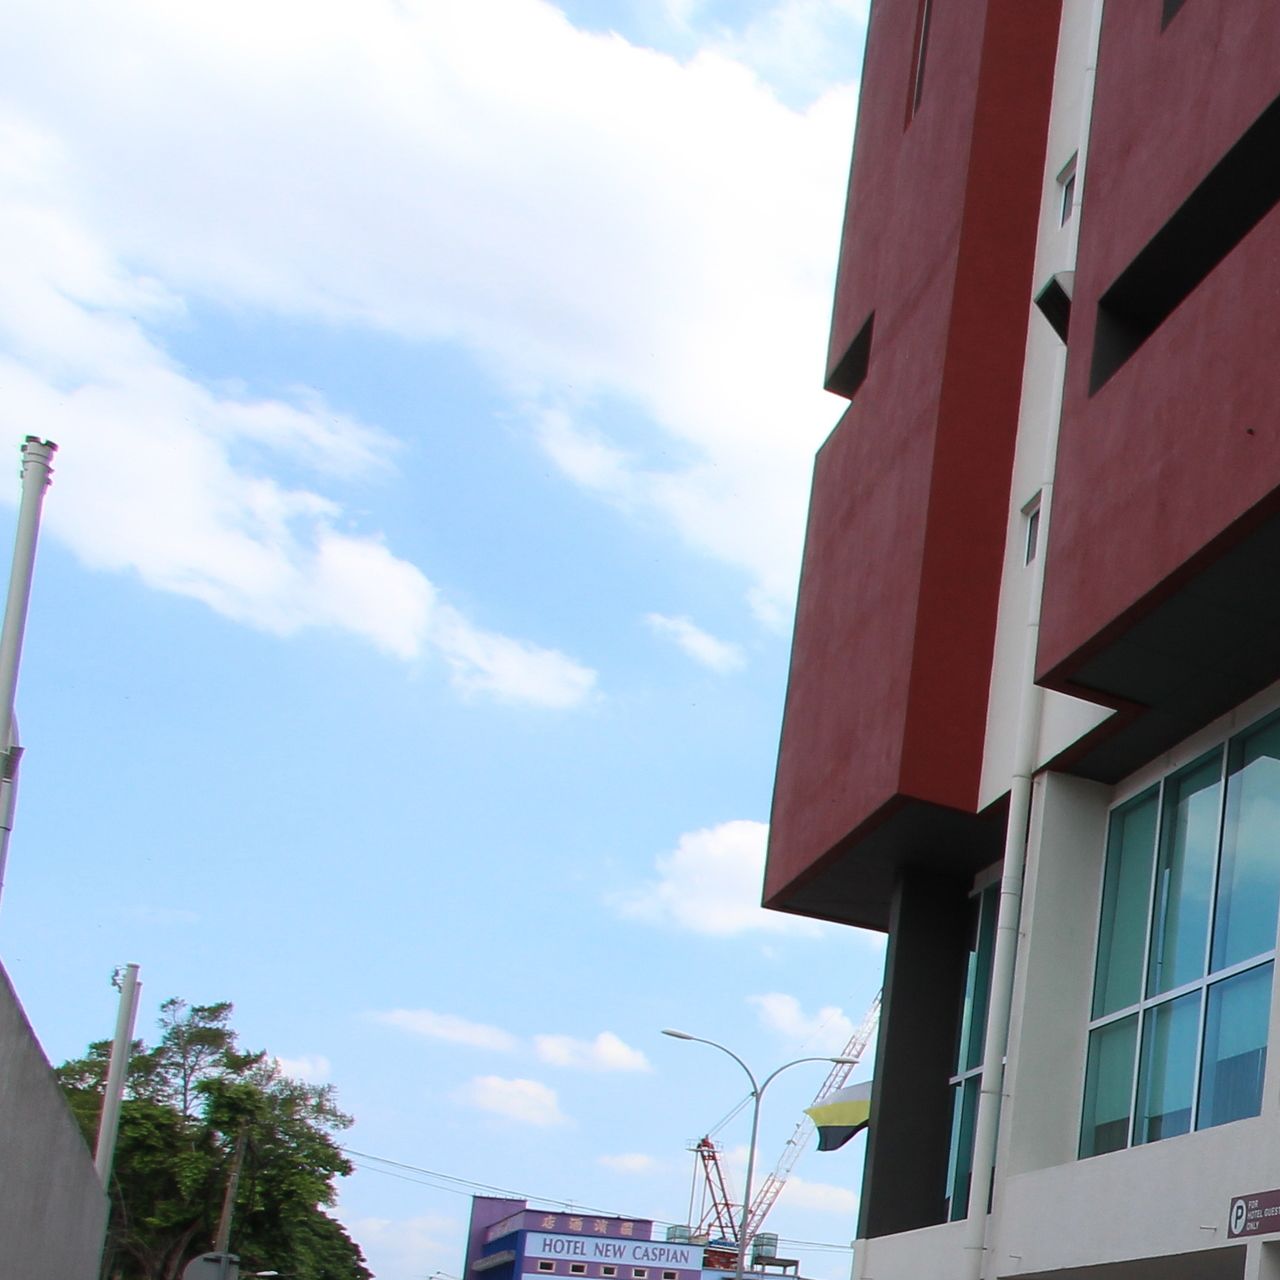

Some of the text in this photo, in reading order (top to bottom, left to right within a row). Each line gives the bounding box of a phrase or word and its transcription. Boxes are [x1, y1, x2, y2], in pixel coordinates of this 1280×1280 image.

[1235, 1205, 1244, 1230] P
[1247, 1210, 1263, 1219] HOTEL
[542, 1237, 690, 1264] HOTEL NEW CASPIAN
